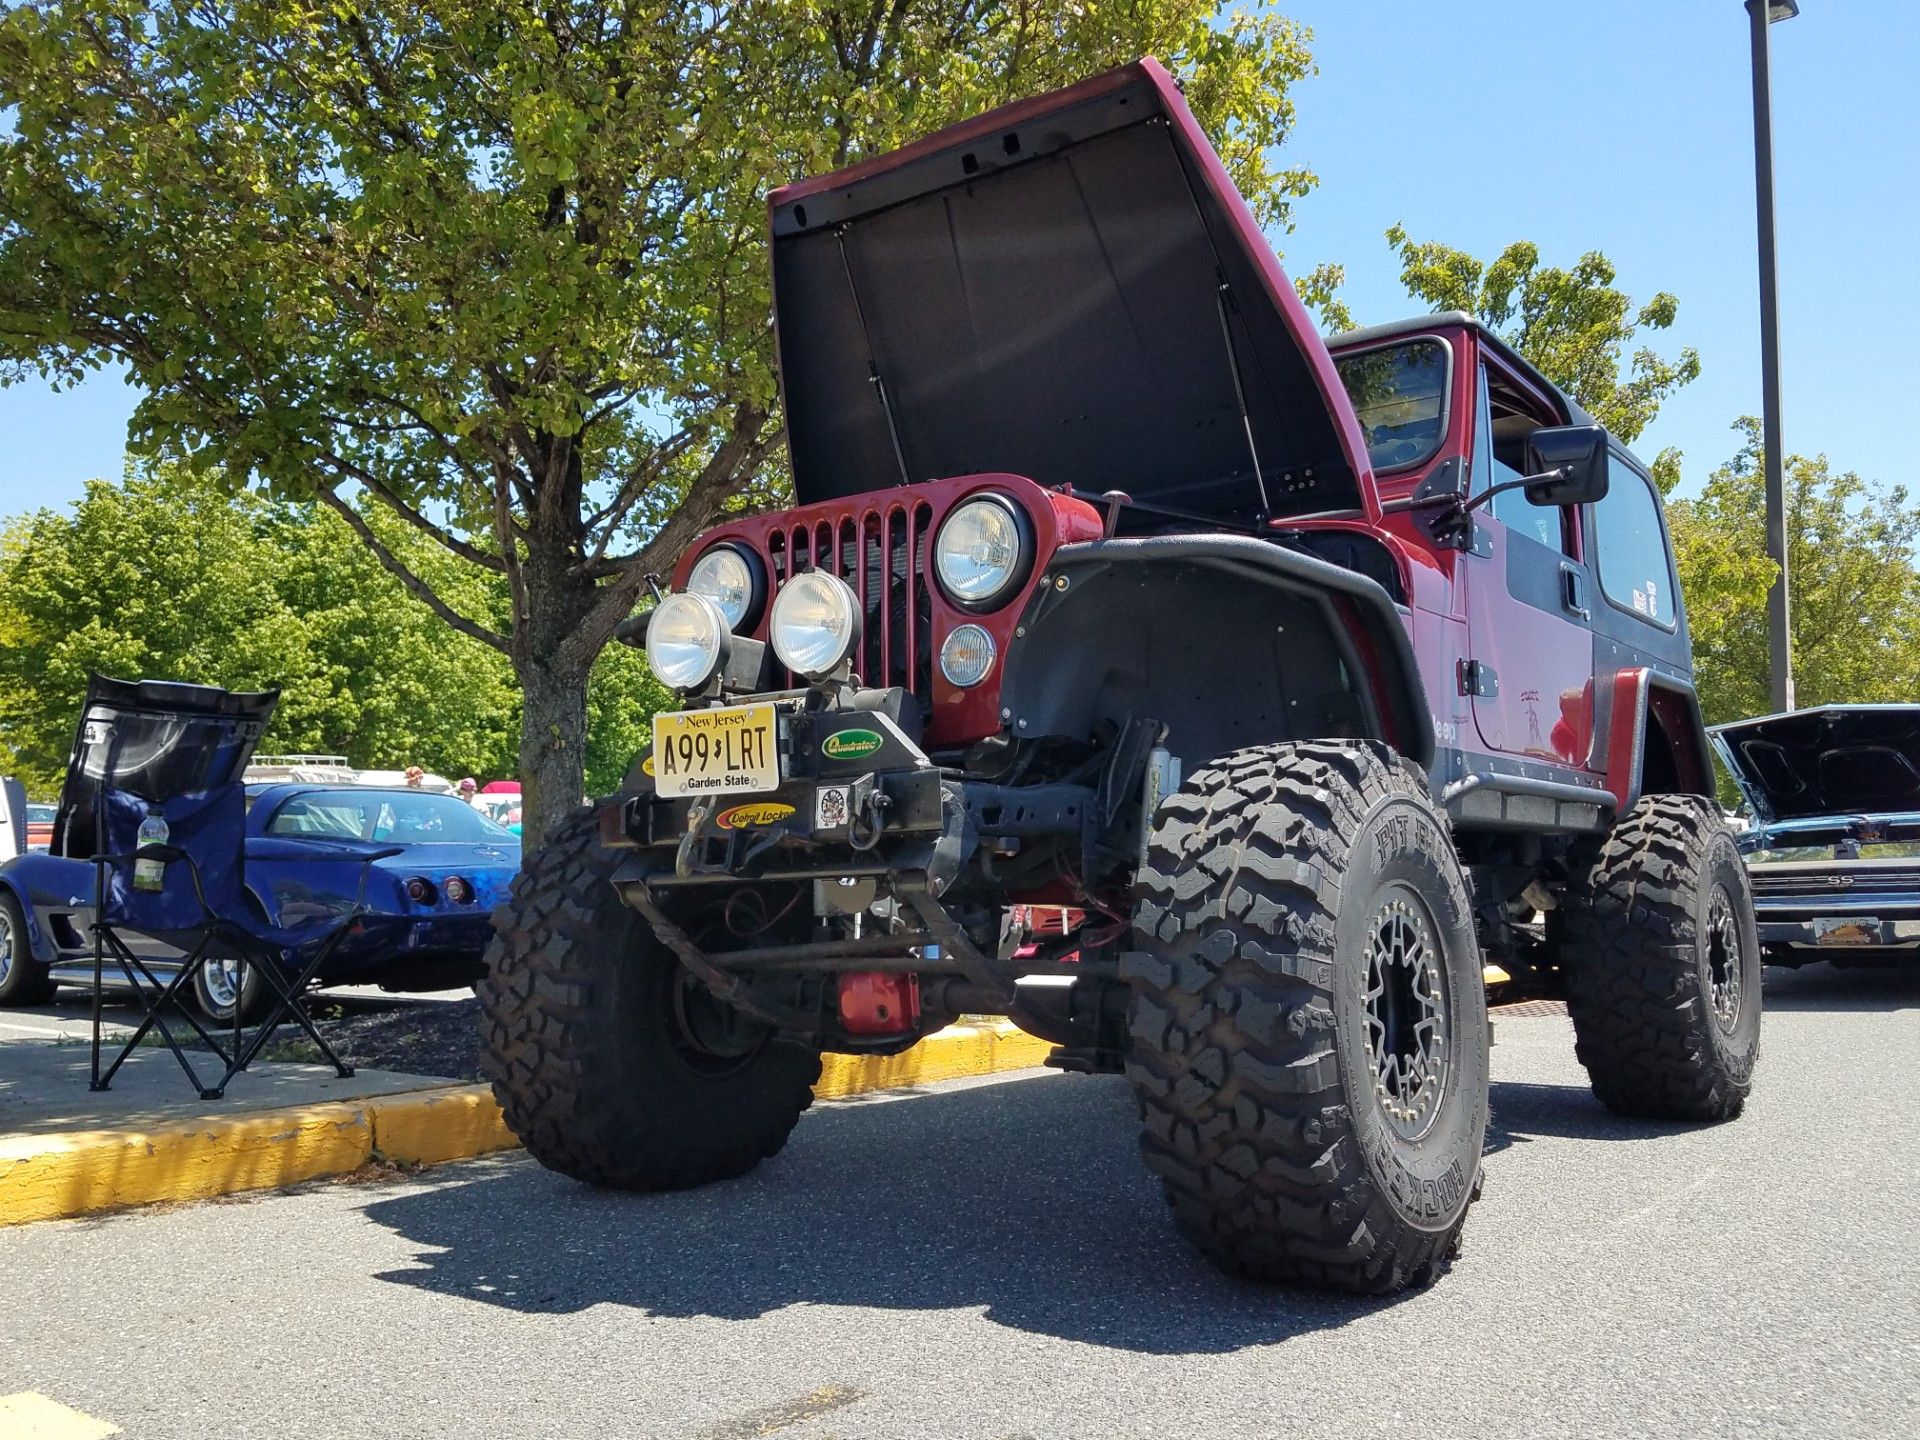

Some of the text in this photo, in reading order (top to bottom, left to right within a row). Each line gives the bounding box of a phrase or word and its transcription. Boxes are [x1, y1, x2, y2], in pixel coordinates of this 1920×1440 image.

[686, 713, 747, 729] New Jersey
[664, 732, 709, 775] A99
[726, 726, 766, 771] LRT
[828, 736, 877, 754] Quadratec
[688, 775, 750, 788] Garden State
[732, 811, 761, 823] Detroit
[1375, 815, 1408, 862] PIT
[1828, 875, 1854, 885] SS
[1376, 1126, 1464, 1218] ROCKER
